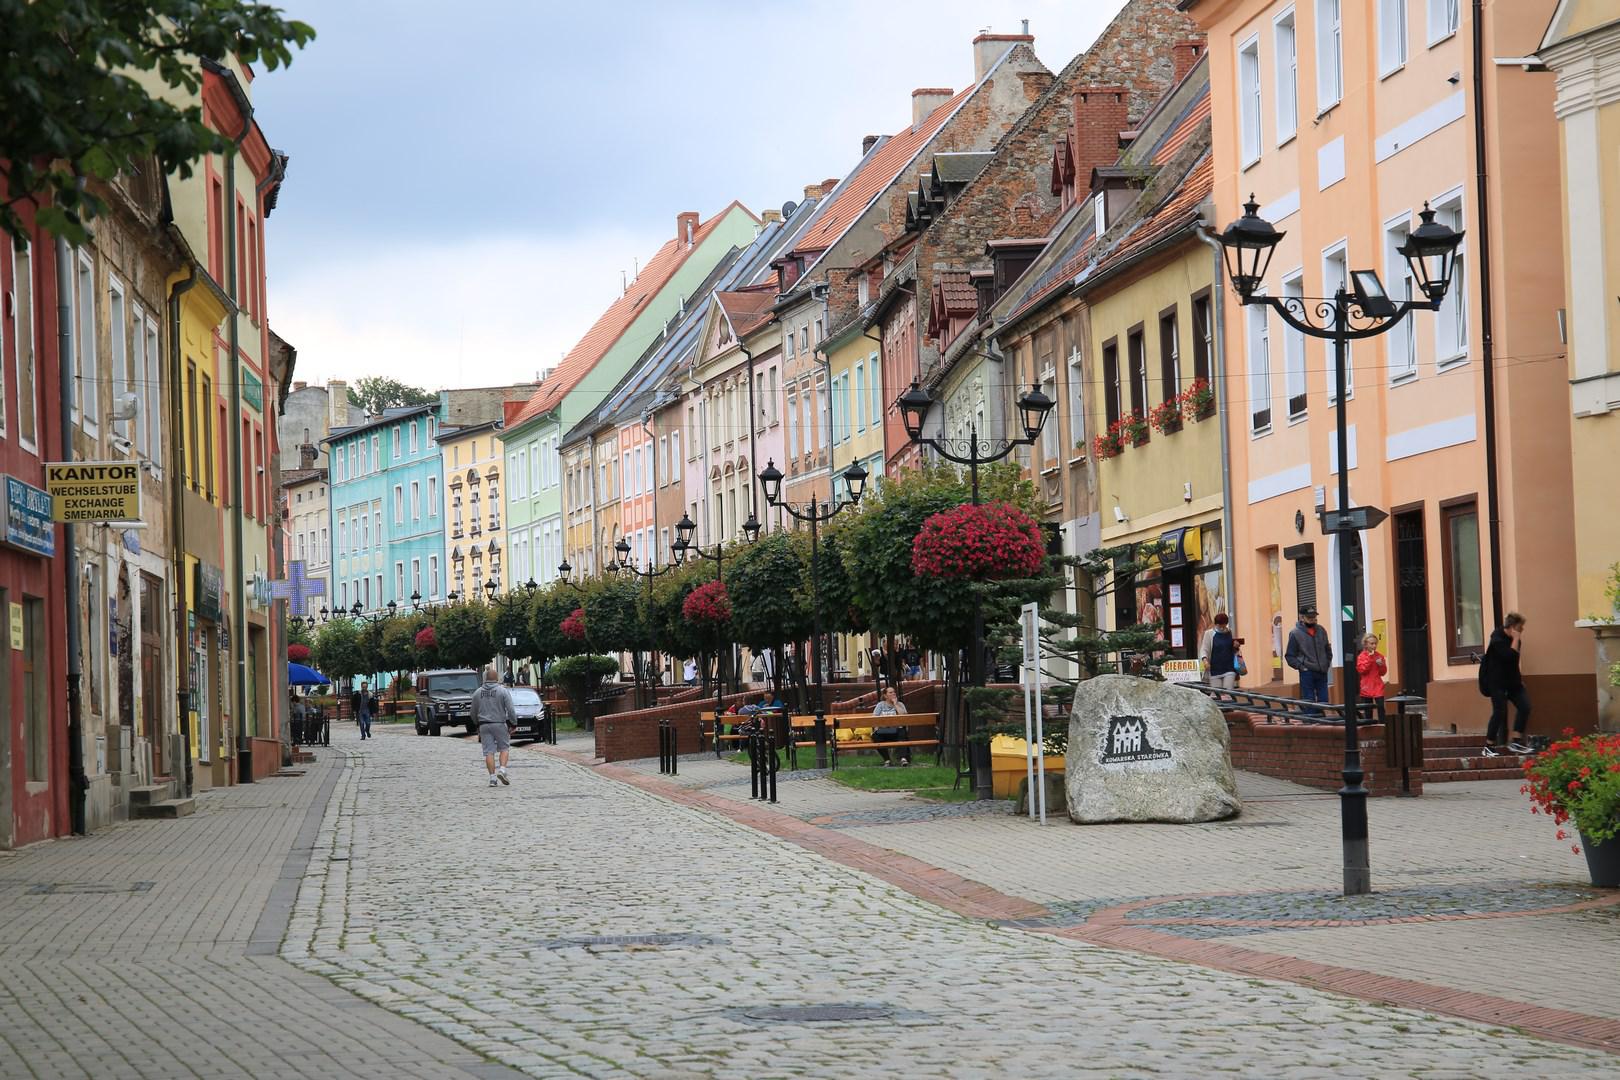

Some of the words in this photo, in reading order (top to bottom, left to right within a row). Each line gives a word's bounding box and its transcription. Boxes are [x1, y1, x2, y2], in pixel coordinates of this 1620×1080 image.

[50, 466, 137, 481] KANTOR
[51, 485, 136, 496] WECHSELSTUBE
[65, 498, 124, 508] EXCHANGE
[64, 509, 125, 520] SMENARNA
